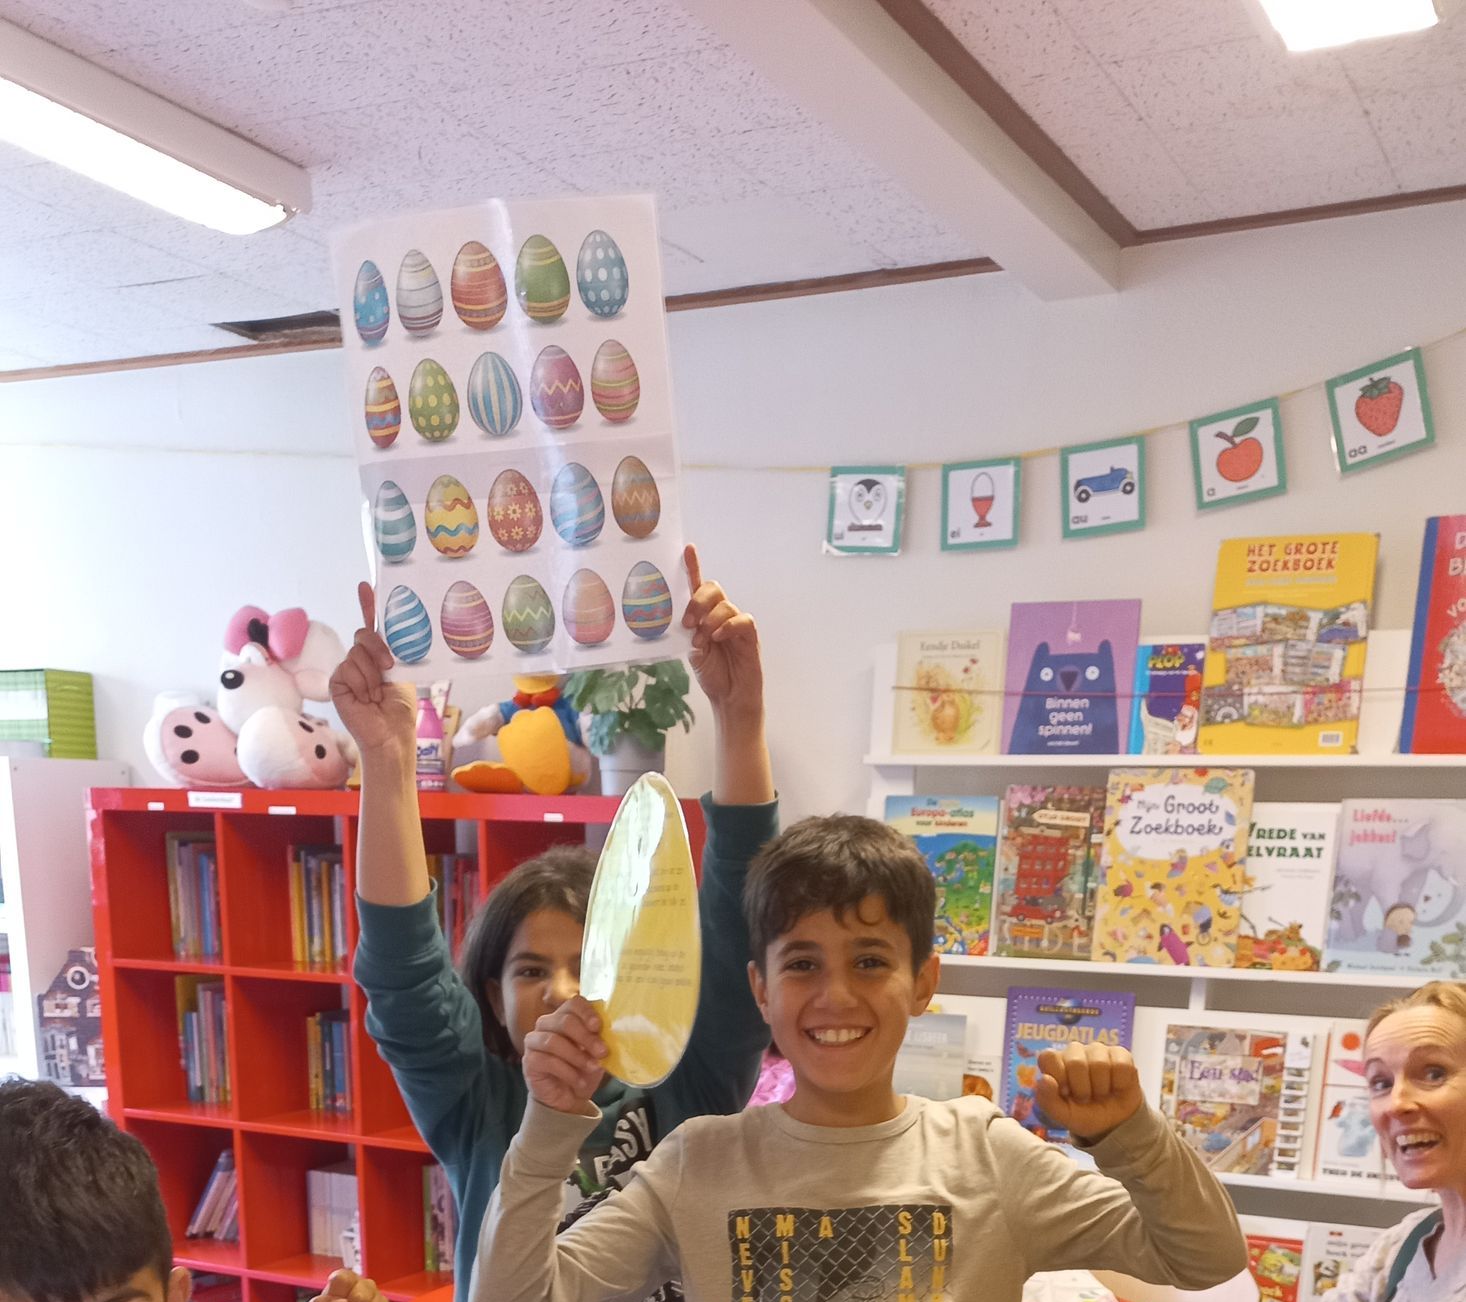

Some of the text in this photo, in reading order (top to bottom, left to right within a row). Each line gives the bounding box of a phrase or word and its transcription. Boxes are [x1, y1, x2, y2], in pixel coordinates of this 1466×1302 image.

[1246, 541, 1339, 557] HET GROTE
[1247, 557, 1336, 573] ZOEKBOEK
[1148, 655, 1185, 669] PLOP
[1045, 696, 1090, 710] Binnen
[1049, 711, 1084, 725] geen
[1038, 722, 1093, 738] spinnen!
[1164, 794, 1220, 814] Groot
[1129, 815, 1224, 835] Zoekboek
[1016, 1023, 1120, 1046] JEUGDATLAS
[818, 1216, 834, 1238] A
